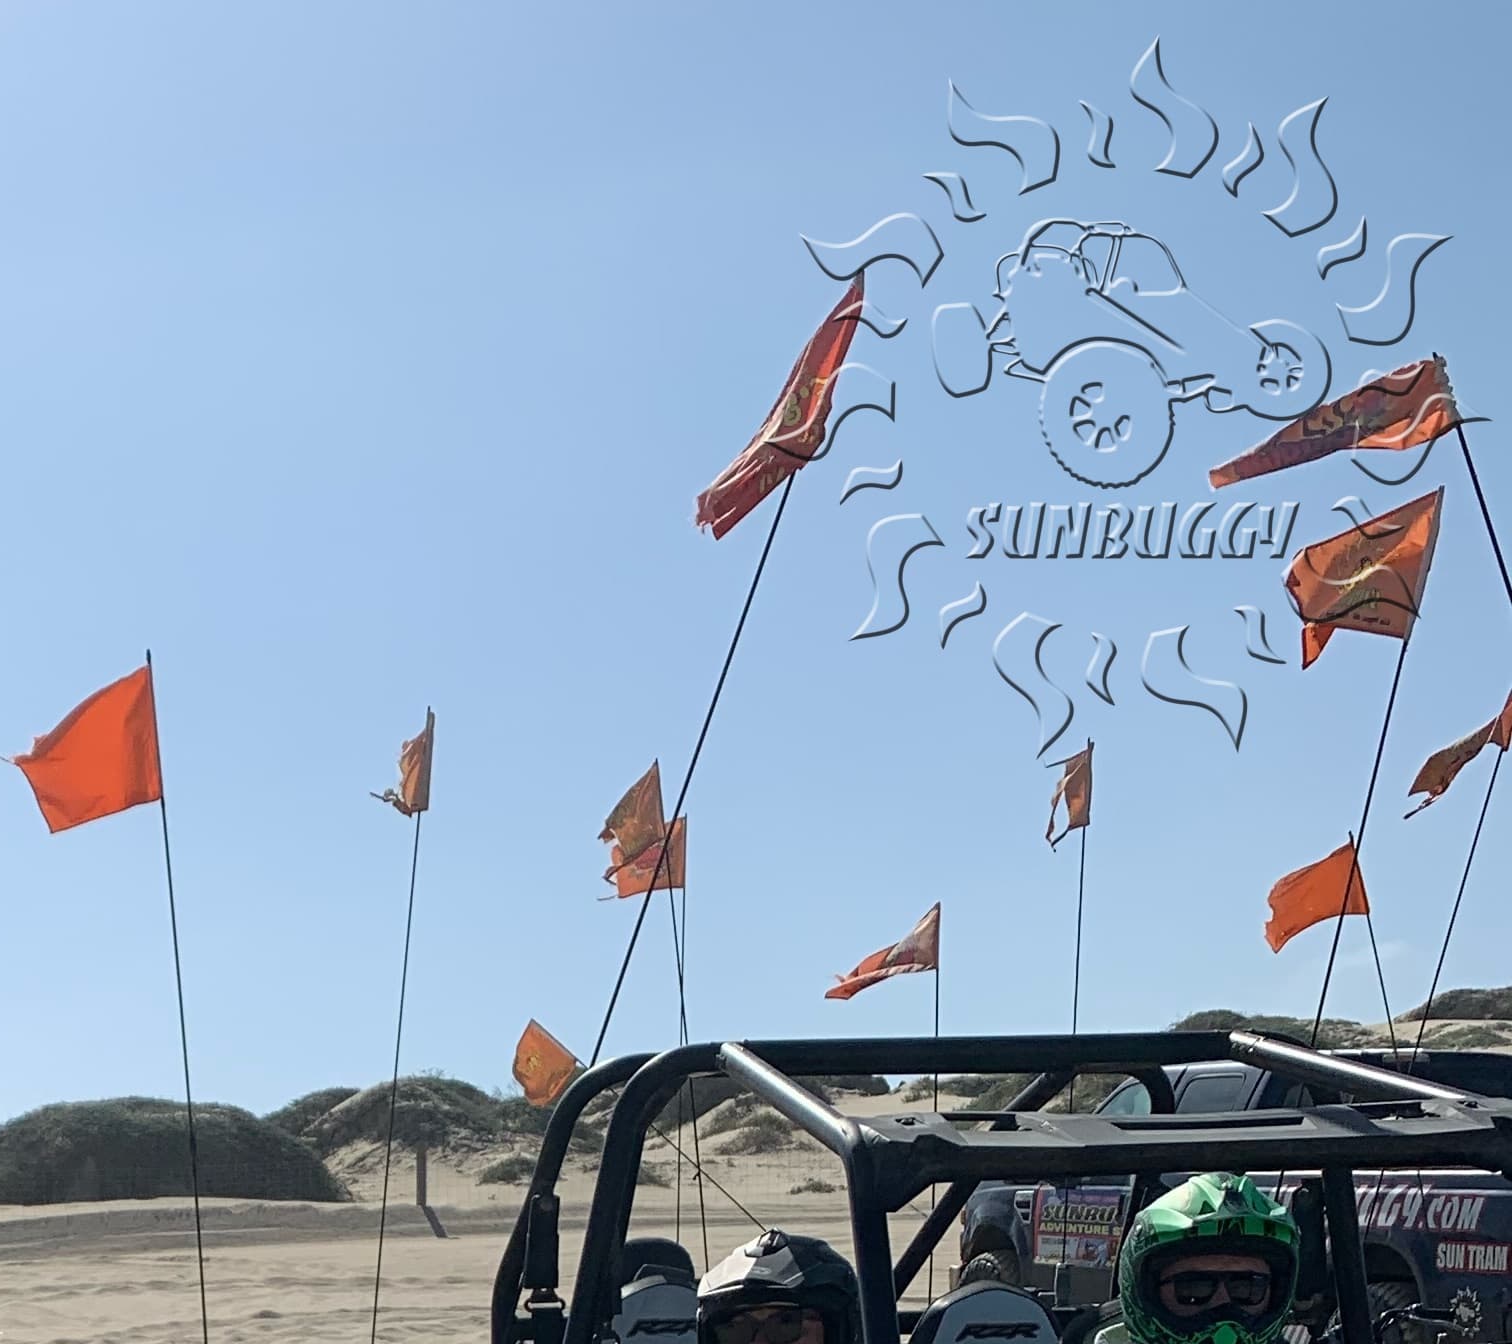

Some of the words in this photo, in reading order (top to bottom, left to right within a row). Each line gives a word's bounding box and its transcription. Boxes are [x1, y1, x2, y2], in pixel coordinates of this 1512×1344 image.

[1040, 1204, 1119, 1224] SUNBU
[1437, 1242, 1465, 1268] SUN
[1468, 1244, 1508, 1271] TRAM
[954, 1322, 1041, 1342] RZR
